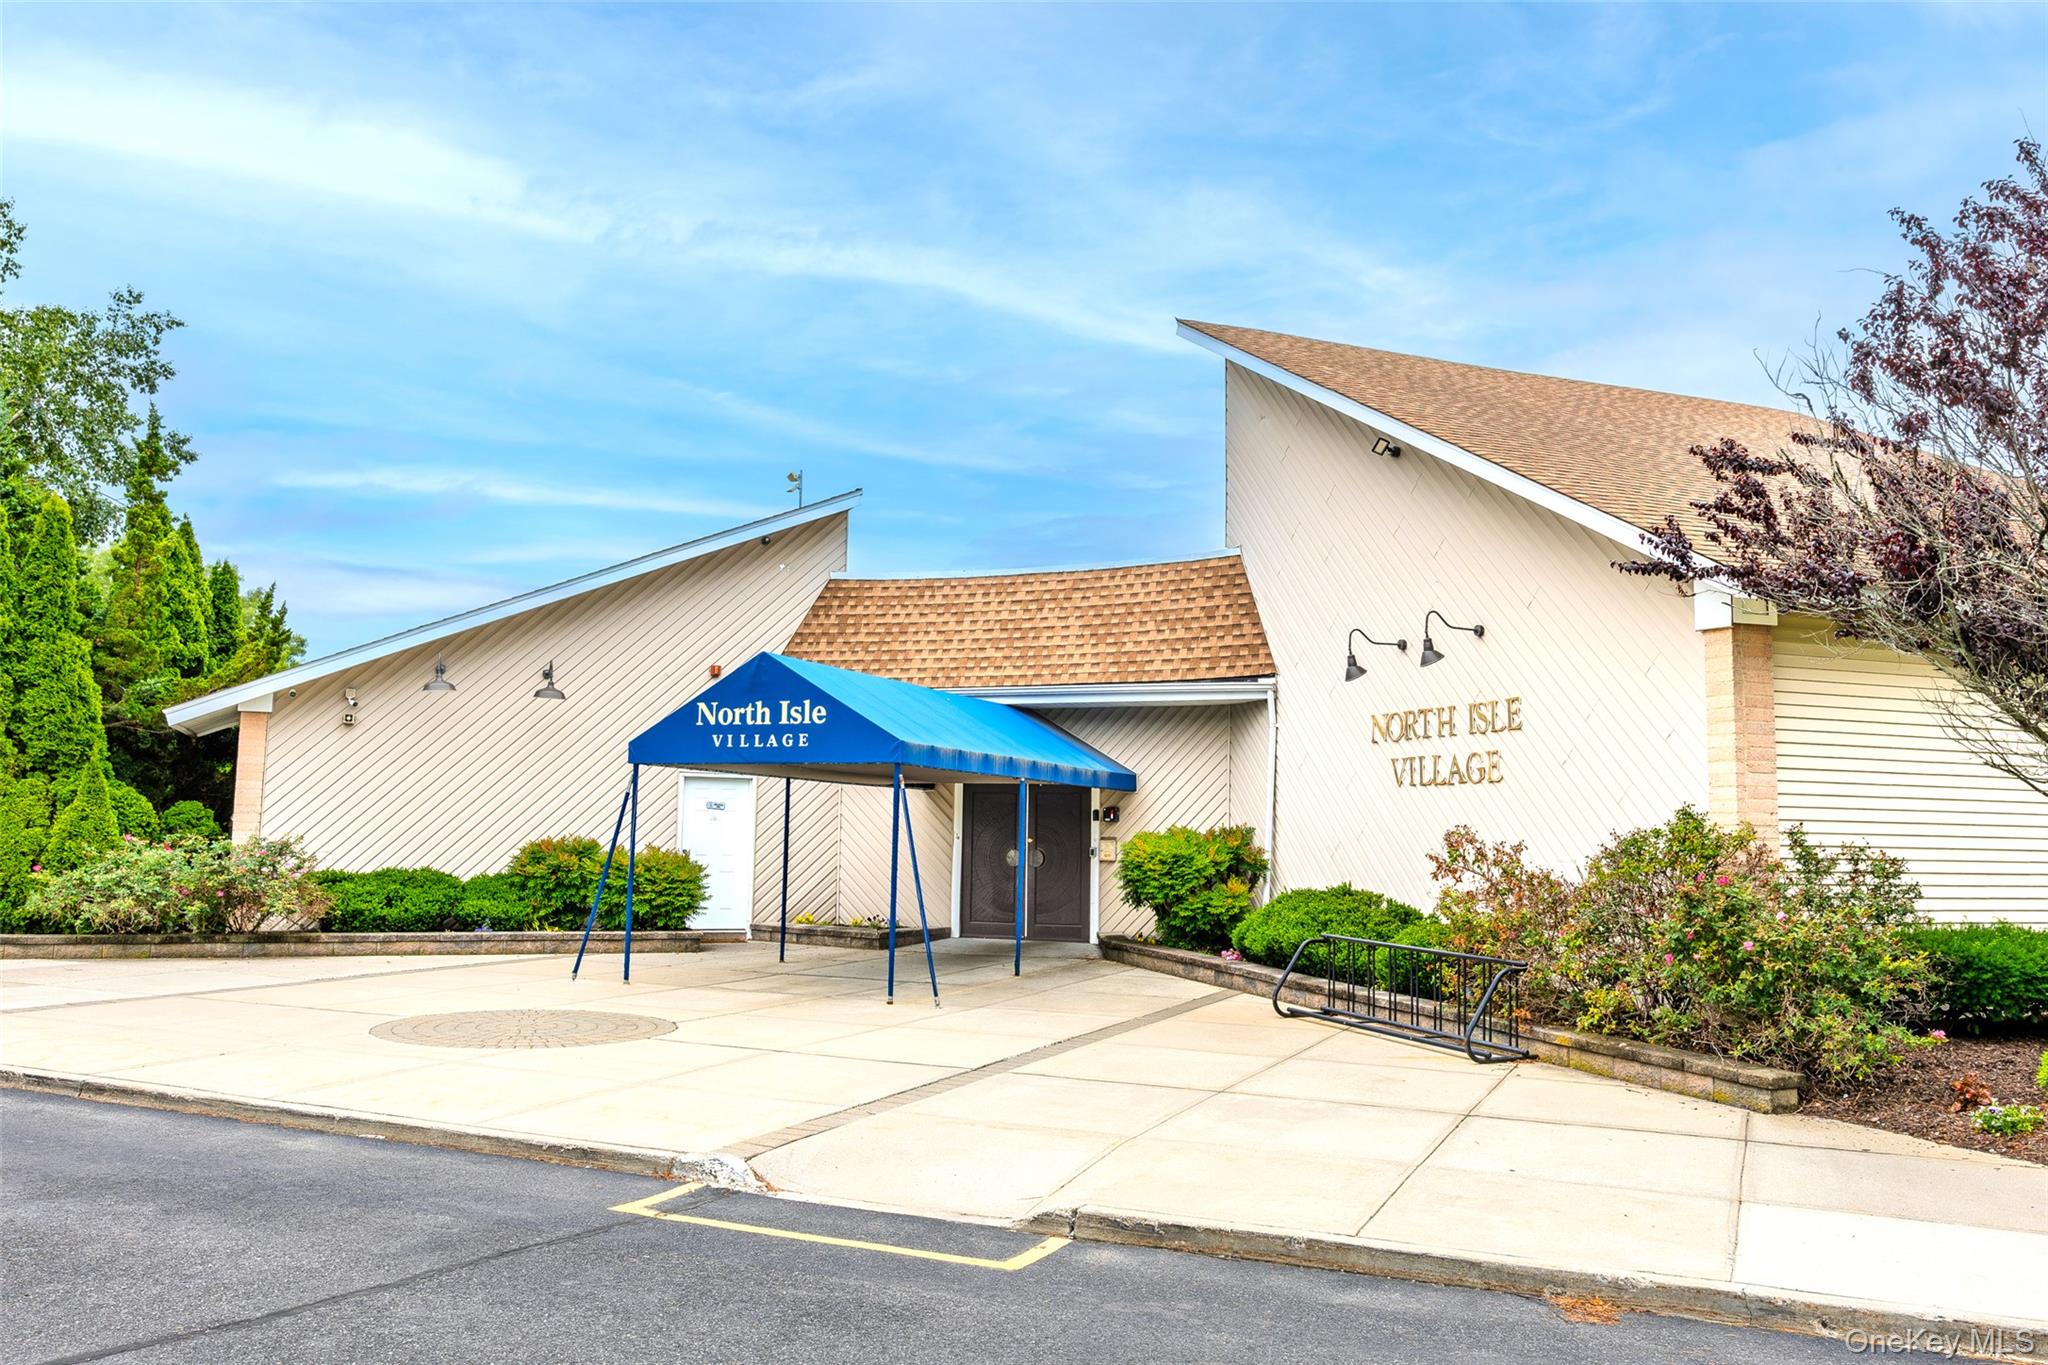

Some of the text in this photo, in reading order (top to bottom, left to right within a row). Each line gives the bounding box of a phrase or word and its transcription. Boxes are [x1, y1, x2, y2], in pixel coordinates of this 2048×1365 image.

[695, 699, 828, 726] North Isle
[1370, 696, 1523, 744] NORTH ISLE
[712, 733, 810, 748] VILLAGE
[1390, 750, 1505, 788] VILLAGE
